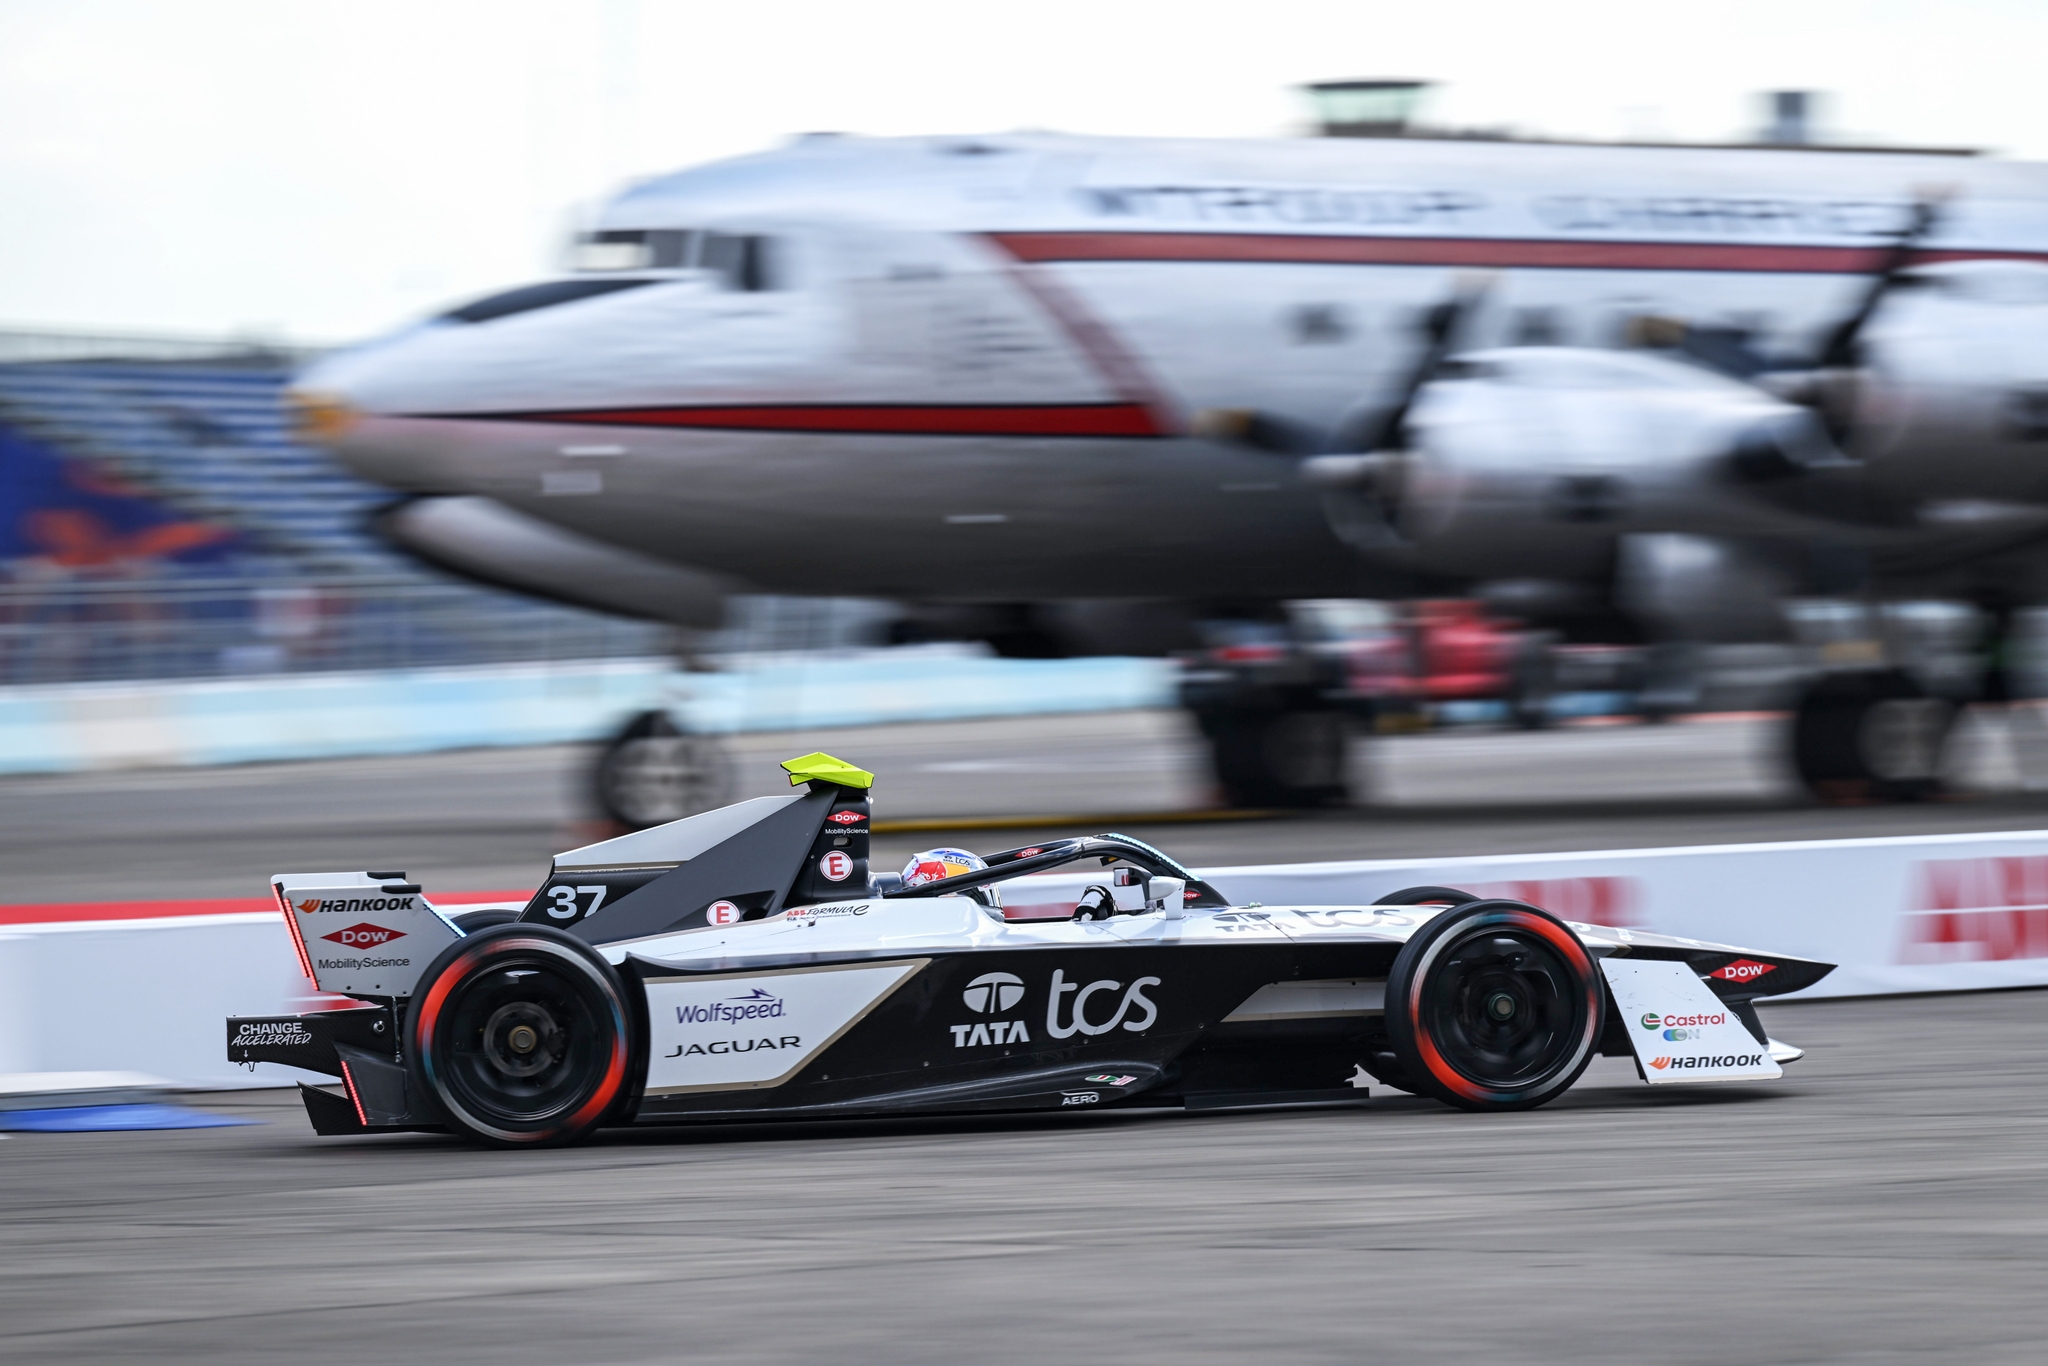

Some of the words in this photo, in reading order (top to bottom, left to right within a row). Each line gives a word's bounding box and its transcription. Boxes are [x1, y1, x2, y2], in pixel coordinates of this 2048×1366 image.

[829, 856, 844, 876] E
[547, 885, 607, 919] 37
[806, 906, 854, 916] FORMULA
[716, 906, 730, 924] E
[1215, 922, 1297, 932] TATA
[1290, 909, 1415, 927] tcs
[318, 957, 410, 970] MobilityScience
[950, 1020, 1030, 1048] TATA
[1046, 969, 1161, 1039] tcs
[1664, 1013, 1725, 1027] Castrol
[664, 1036, 801, 1058] JAGUAR
[1061, 1094, 1100, 1106] AERO
